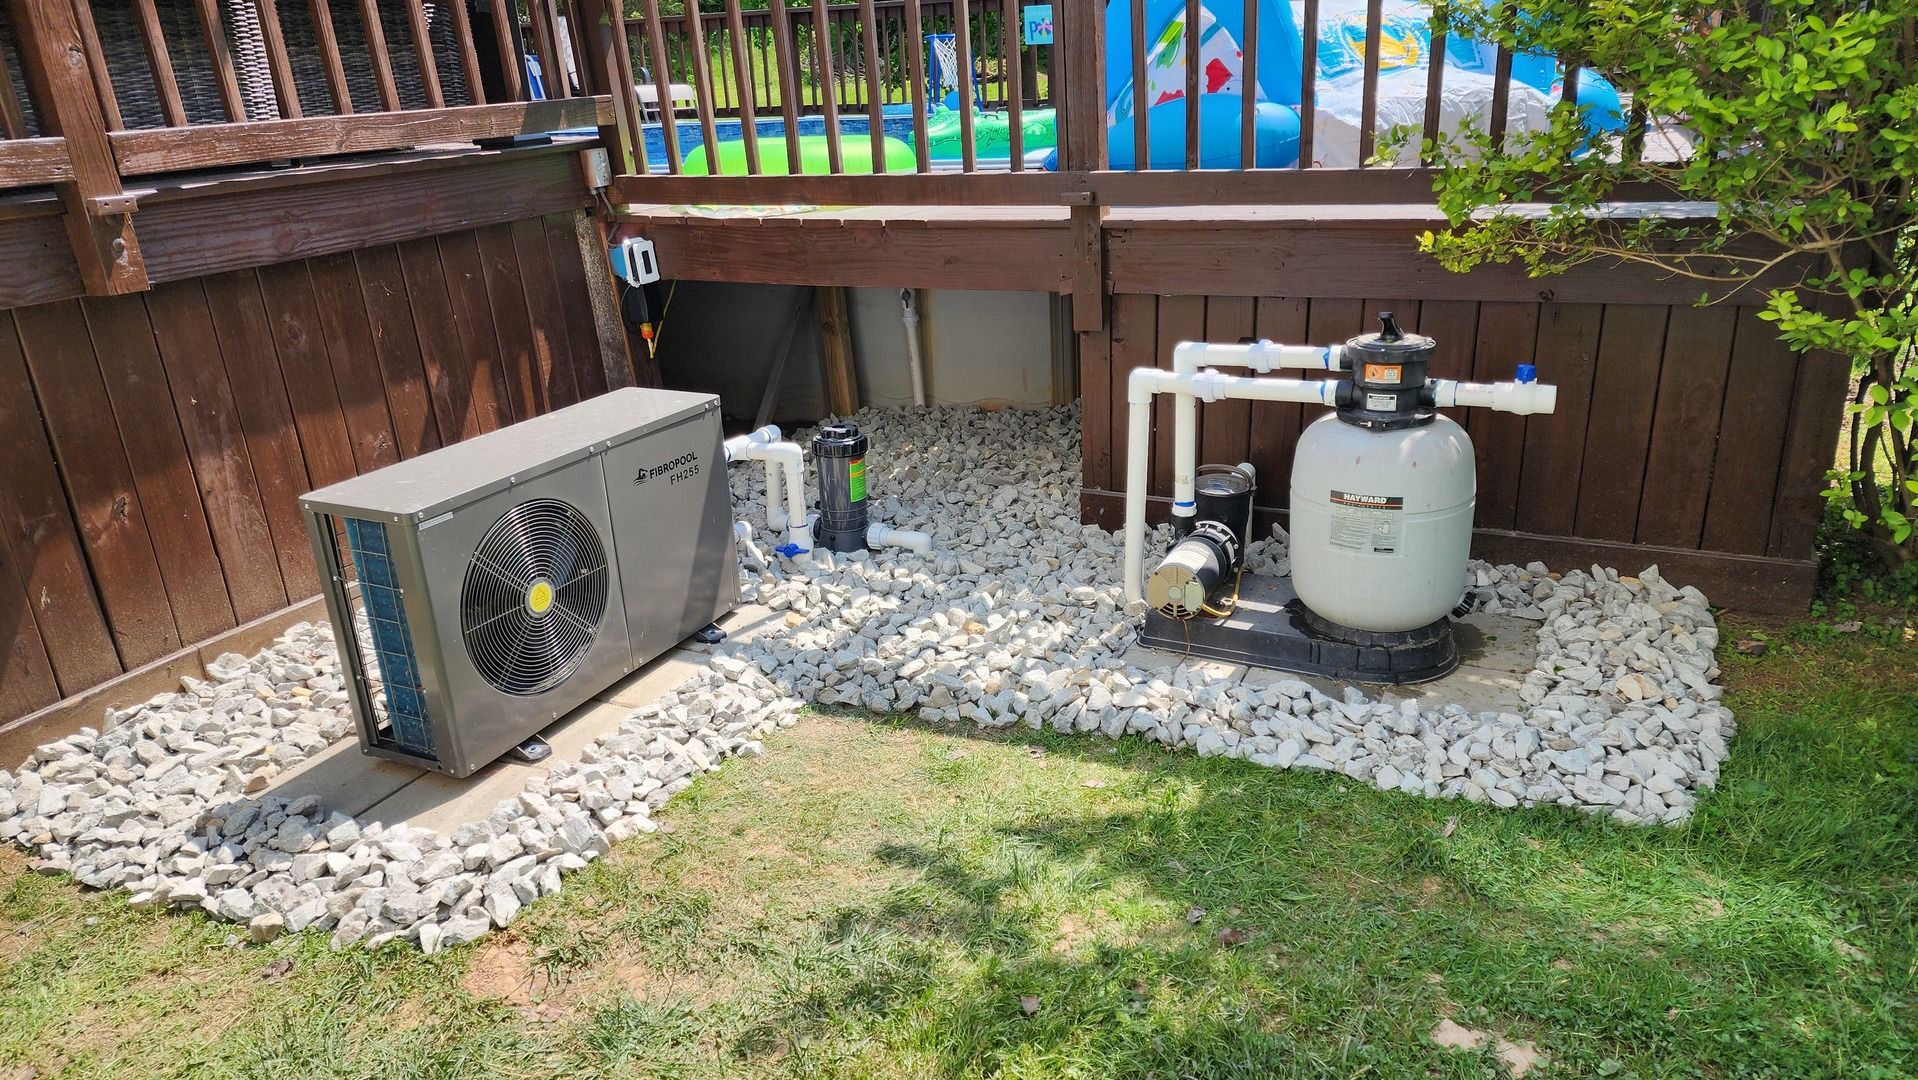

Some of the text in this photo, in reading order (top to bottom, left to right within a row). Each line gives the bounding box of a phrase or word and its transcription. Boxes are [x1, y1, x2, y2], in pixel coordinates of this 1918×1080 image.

[649, 451, 698, 479] FIBROPOOL
[670, 464, 700, 485] FH255
[1343, 493, 1387, 504] HAYWARD
